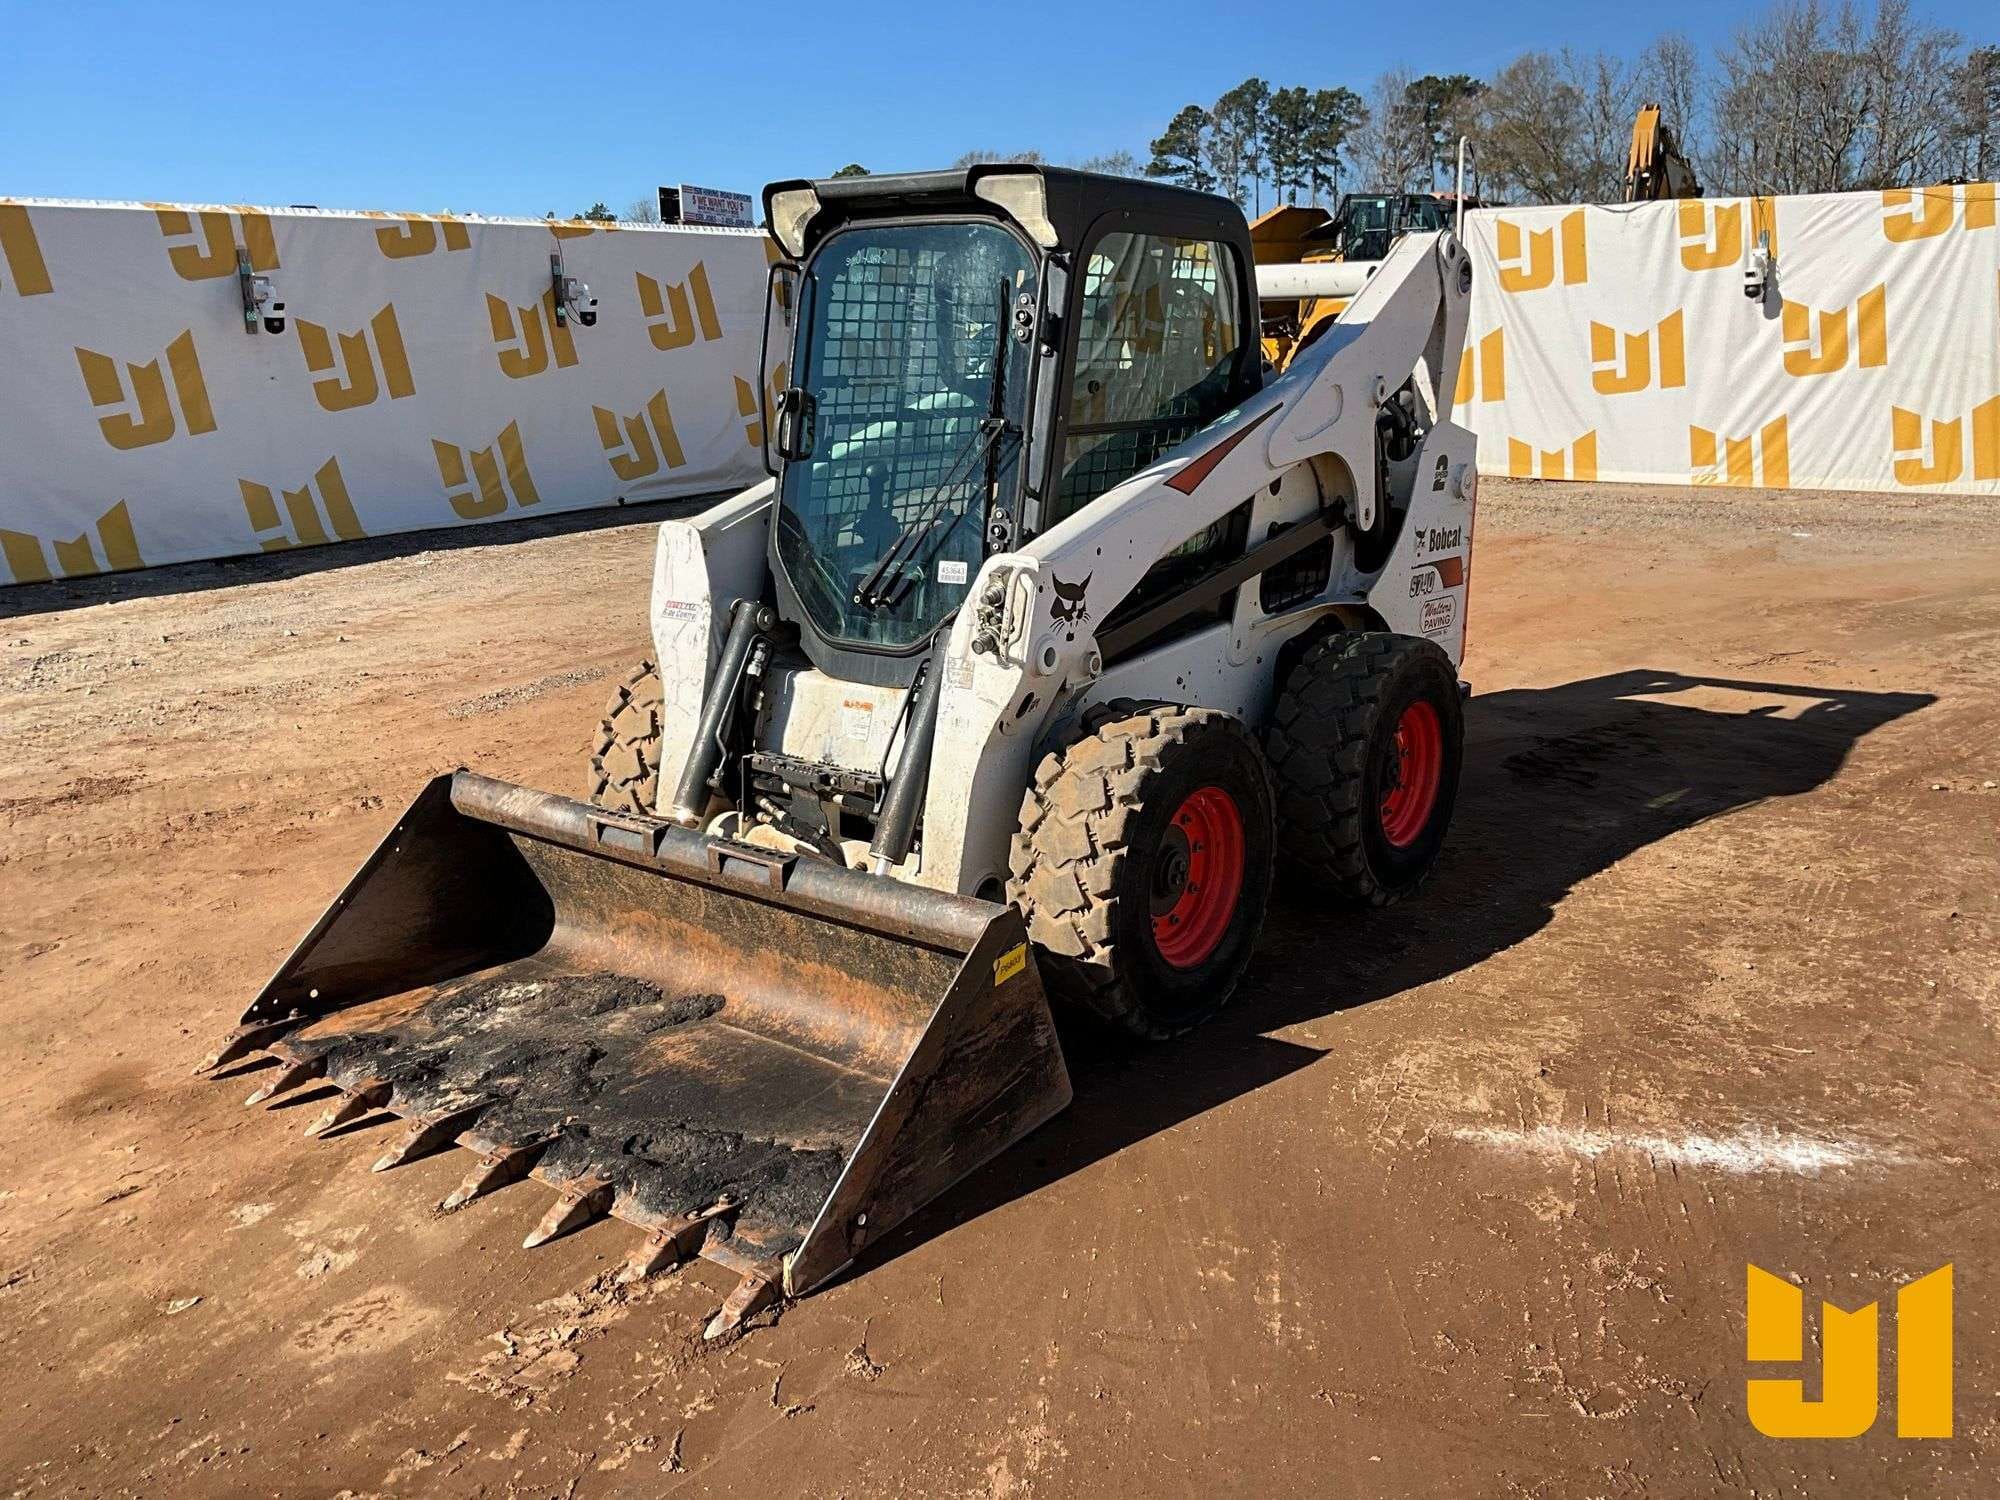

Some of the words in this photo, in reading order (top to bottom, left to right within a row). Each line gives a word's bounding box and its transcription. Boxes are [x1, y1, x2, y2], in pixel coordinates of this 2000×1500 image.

[697, 196, 707, 206] WE
[708, 197, 725, 208] WANT
[1428, 525, 1462, 552] Bobcat
[1424, 614, 1451, 631] PAVING
